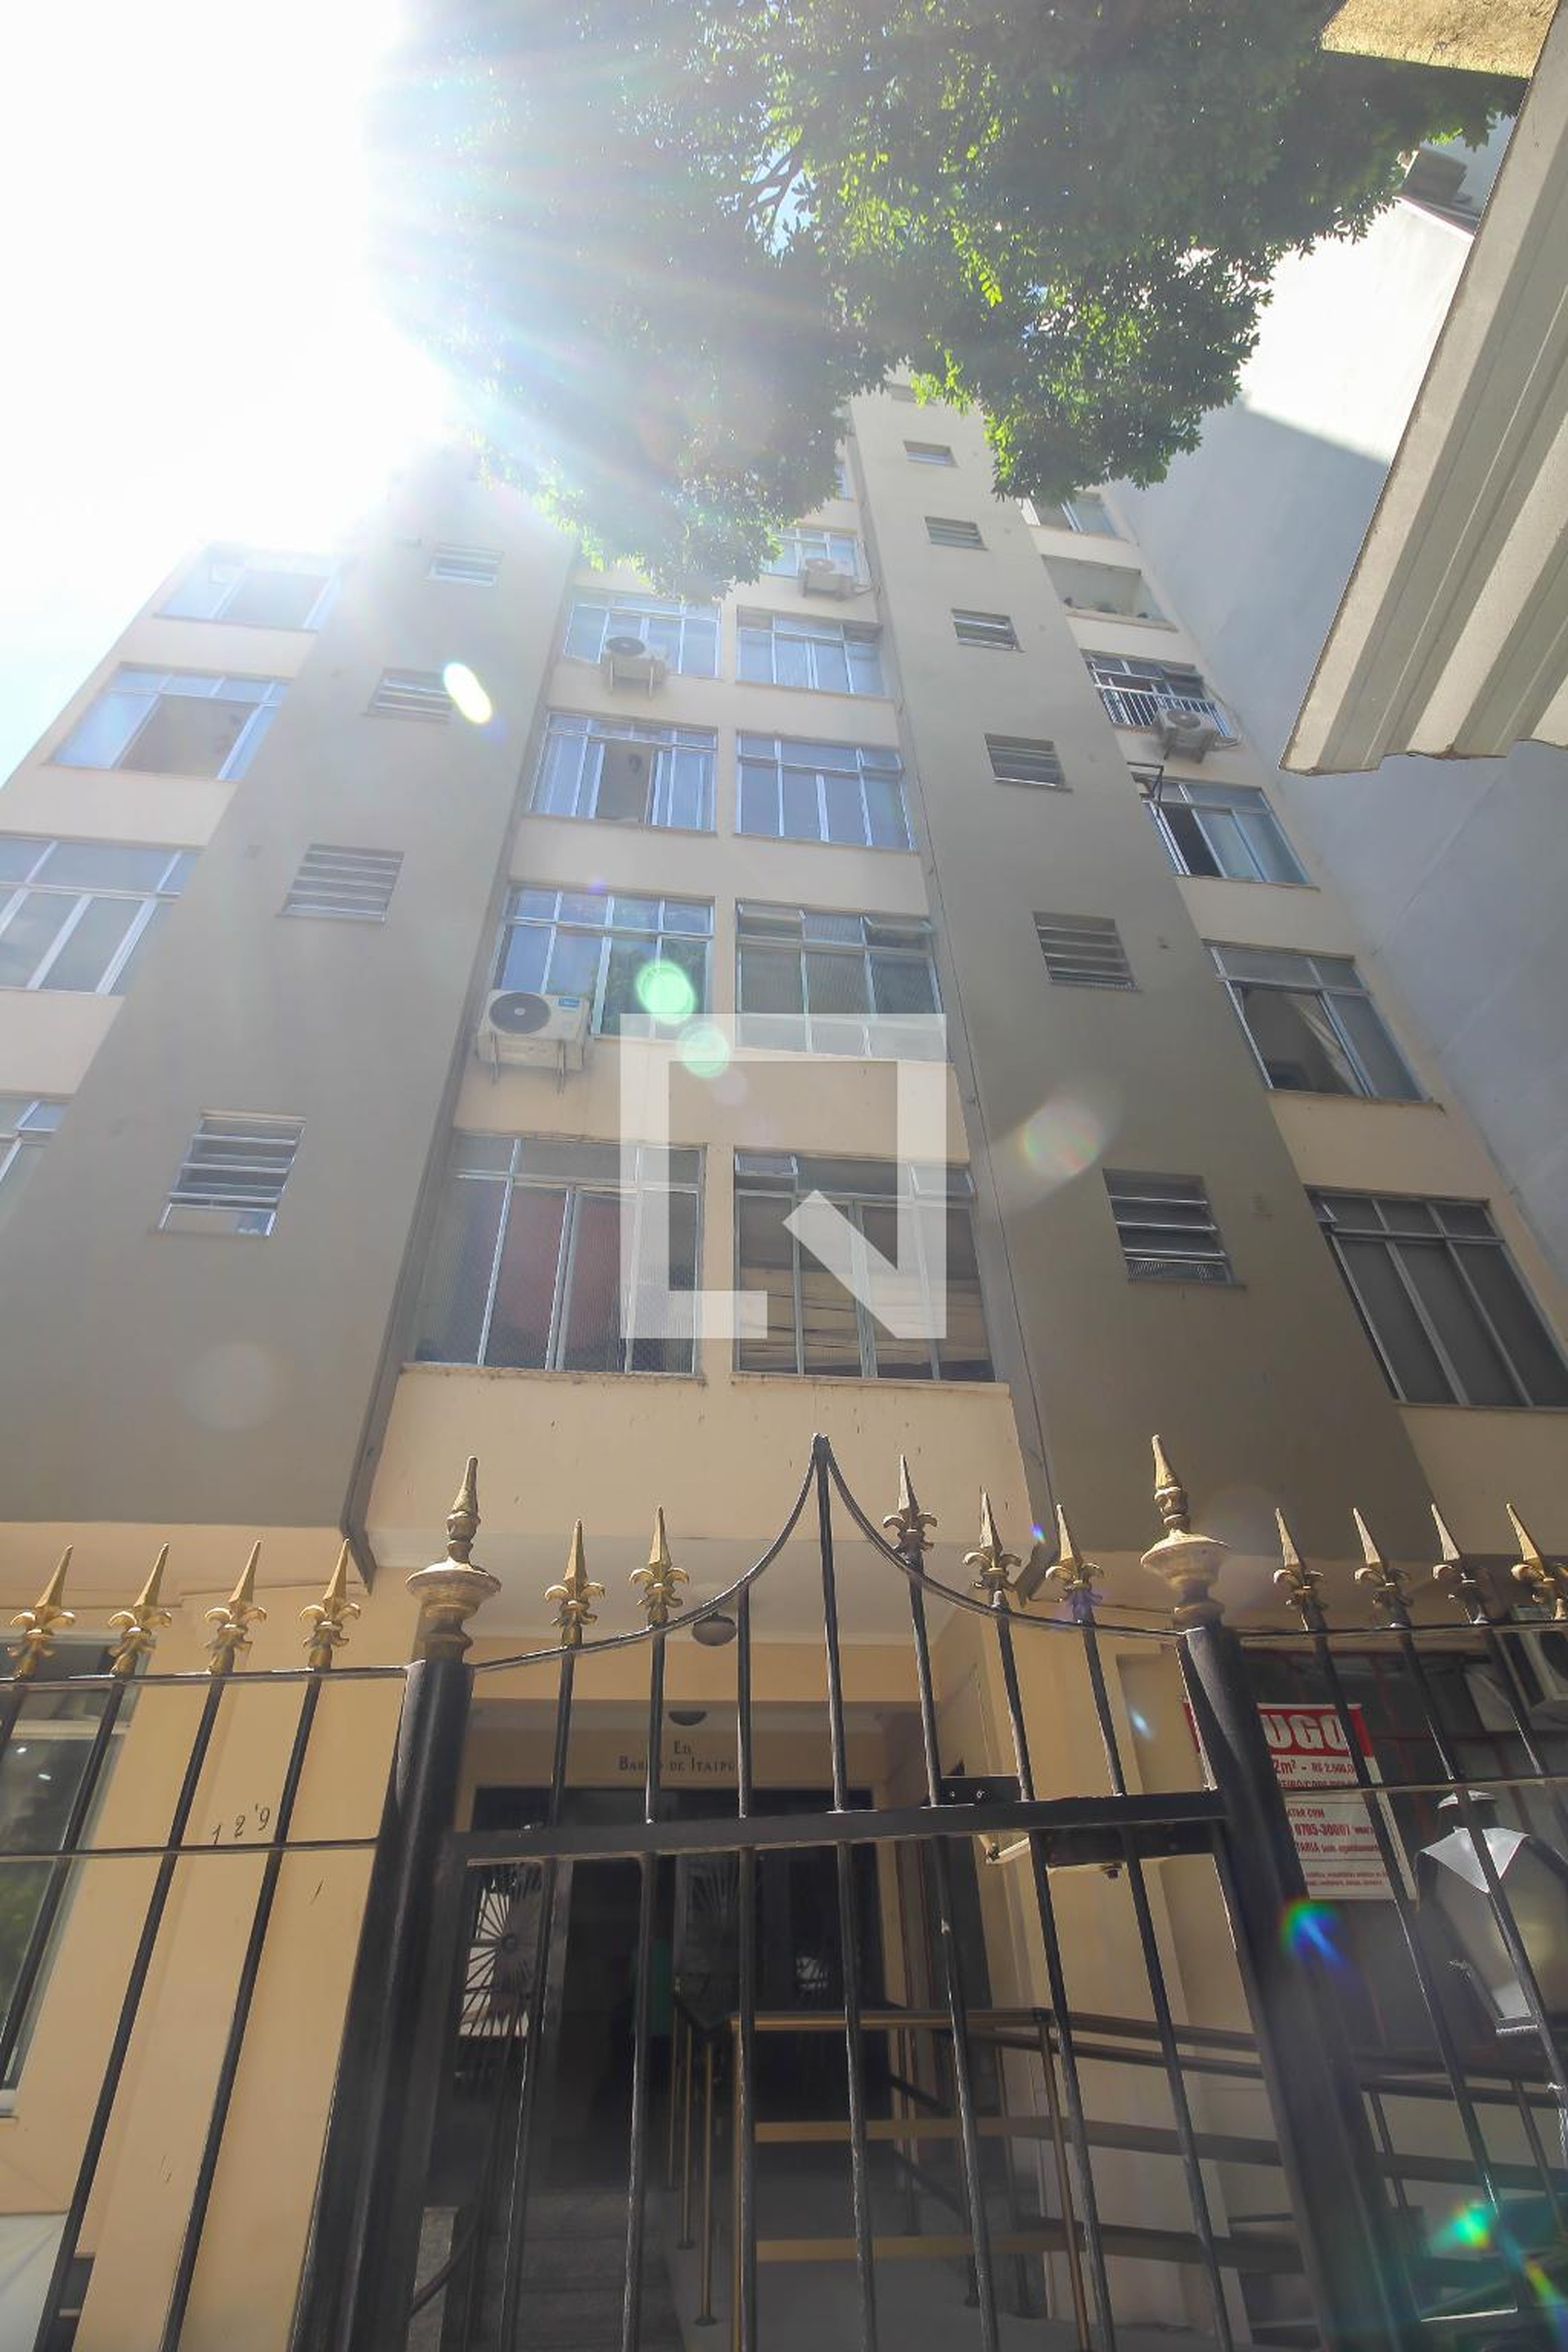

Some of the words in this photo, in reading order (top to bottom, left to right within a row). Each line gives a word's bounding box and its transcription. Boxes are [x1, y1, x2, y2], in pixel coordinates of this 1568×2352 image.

[1260, 1714, 1348, 1750] UGO
[1274, 1759, 1296, 1774] 2m²
[212, 1806, 271, 1845] 129
